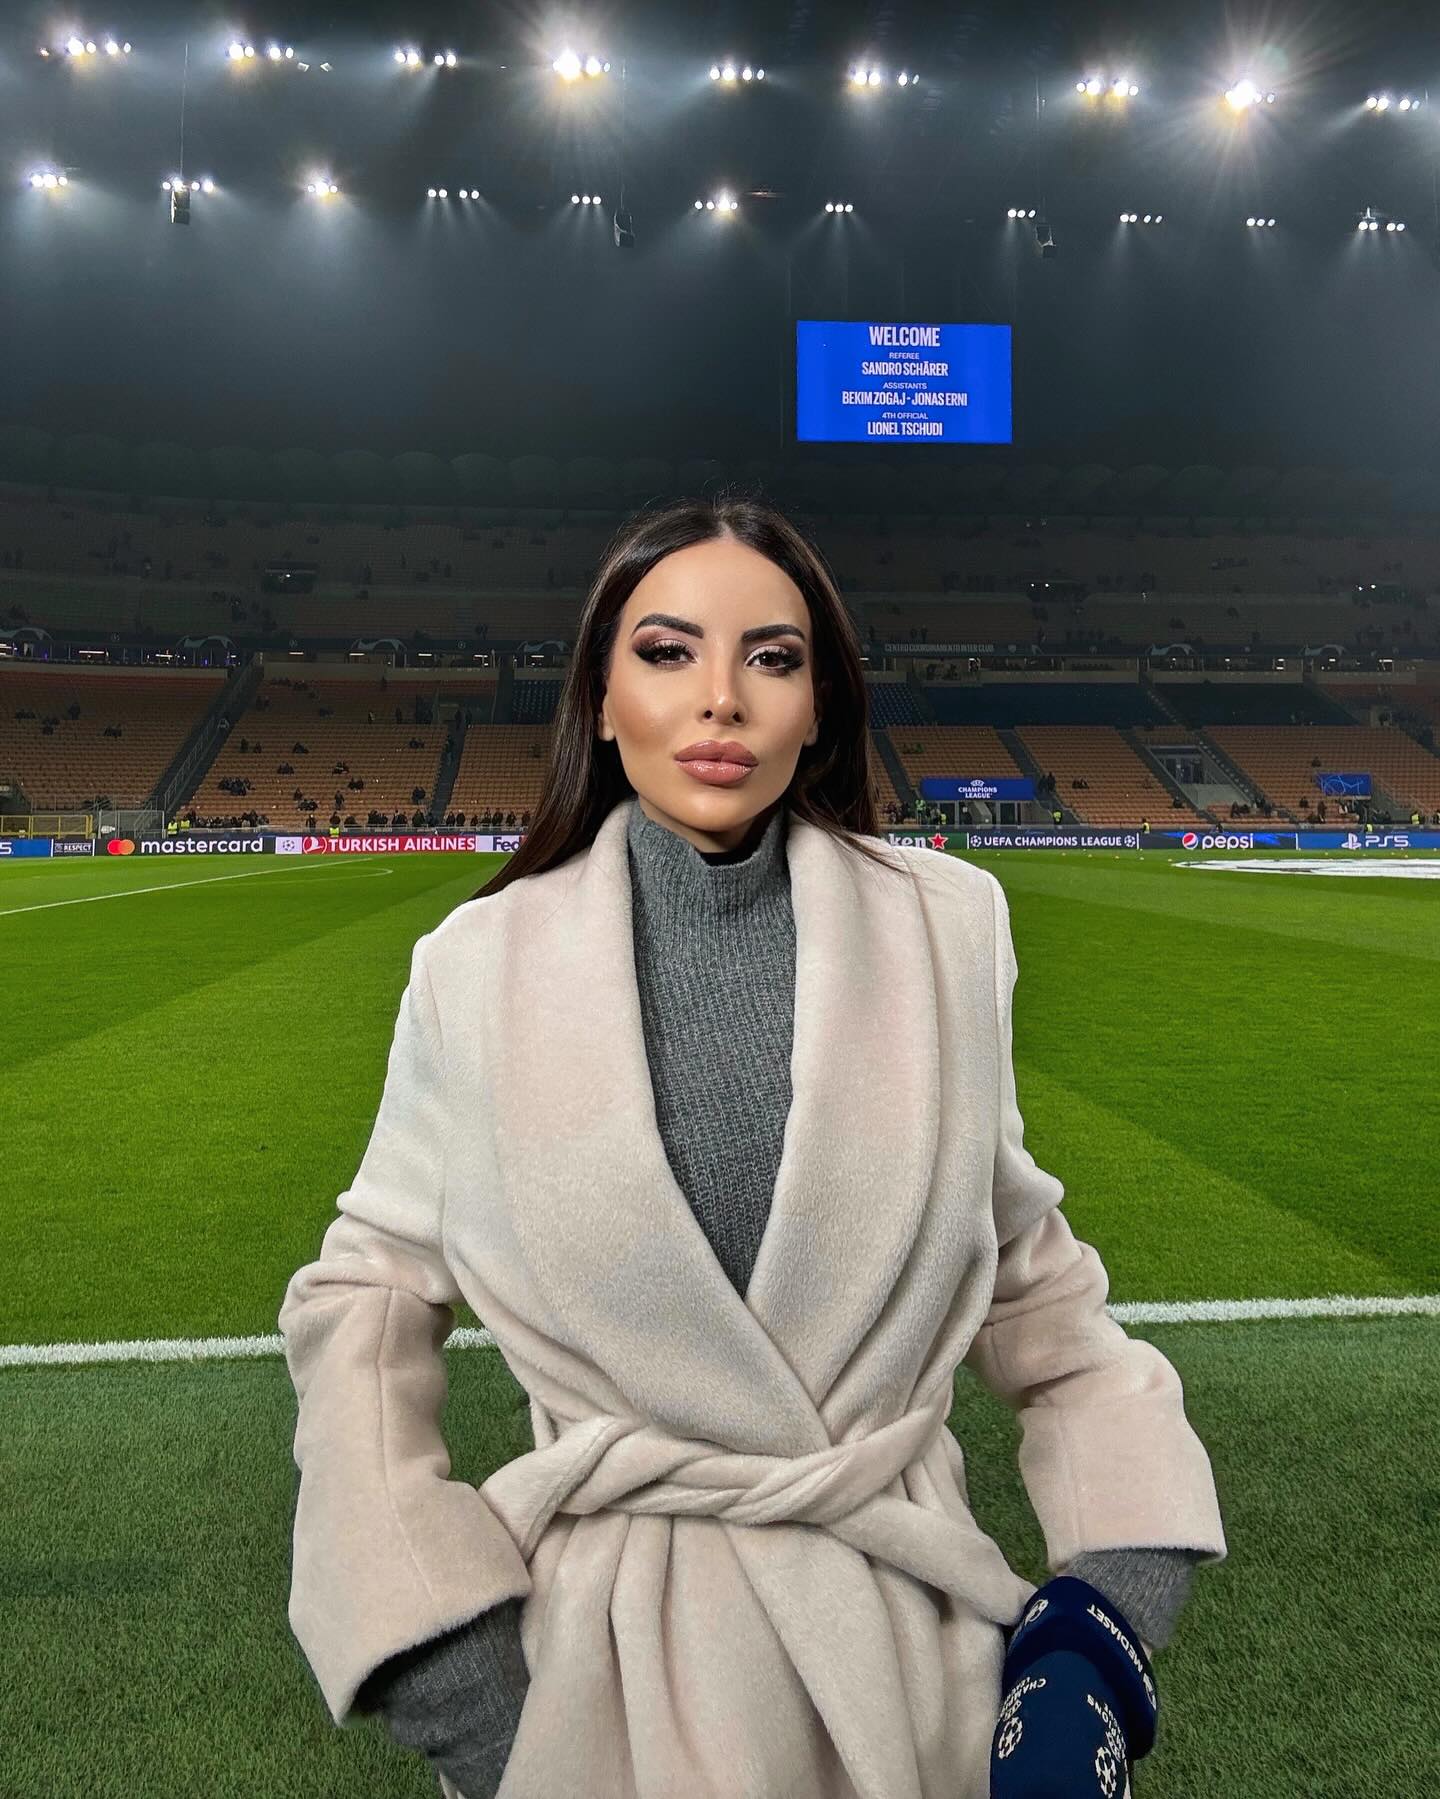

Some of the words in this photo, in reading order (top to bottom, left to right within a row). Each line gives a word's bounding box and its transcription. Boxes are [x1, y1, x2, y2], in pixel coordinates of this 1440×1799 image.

[869, 326, 941, 347] WELCOME
[889, 352, 920, 360] REFEREE
[862, 361, 902, 376] SANDRO
[903, 361, 949, 376] SCHÄRER
[883, 382, 928, 390] ASSISTANTS
[842, 391, 873, 405] BEKIM
[873, 392, 906, 406] ZOGAJ
[911, 392, 945, 406] JONAS
[945, 393, 968, 406] ERNI
[897, 412, 929, 420] OFFICIAL
[867, 421, 900, 436] LIONEL
[901, 422, 943, 436] TSCHUDI
[141, 837, 263, 854] mastercard
[329, 837, 400, 852] TURKISH
[403, 836, 476, 851] AIRLINES
[492, 836, 522, 852] Fed
[887, 833, 927, 849] ken
[984, 836, 1013, 847] UEFA
[1014, 836, 1078, 847] CHAMPIONS
[1081, 836, 1122, 847] LEAGUE
[1202, 833, 1254, 850] pepsi
[1365, 835, 1409, 848] PS5
[1086, 1603, 1144, 1673] MEDIASET
